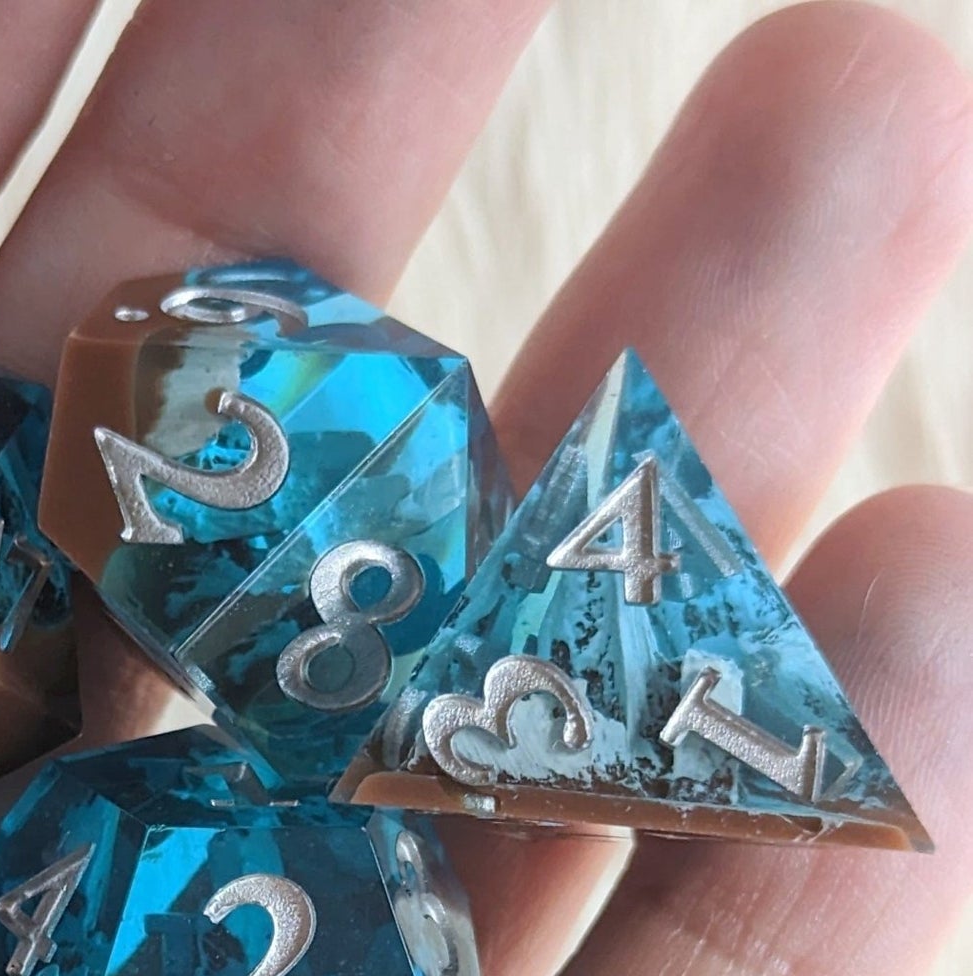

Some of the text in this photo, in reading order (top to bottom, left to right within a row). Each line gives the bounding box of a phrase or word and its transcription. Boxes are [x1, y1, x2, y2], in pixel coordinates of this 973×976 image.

[94, 391, 289, 544] 2
[546, 453, 681, 606] 4
[276, 539, 425, 712] 8
[422, 654, 594, 787] 3
[660, 665, 828, 805] 1
